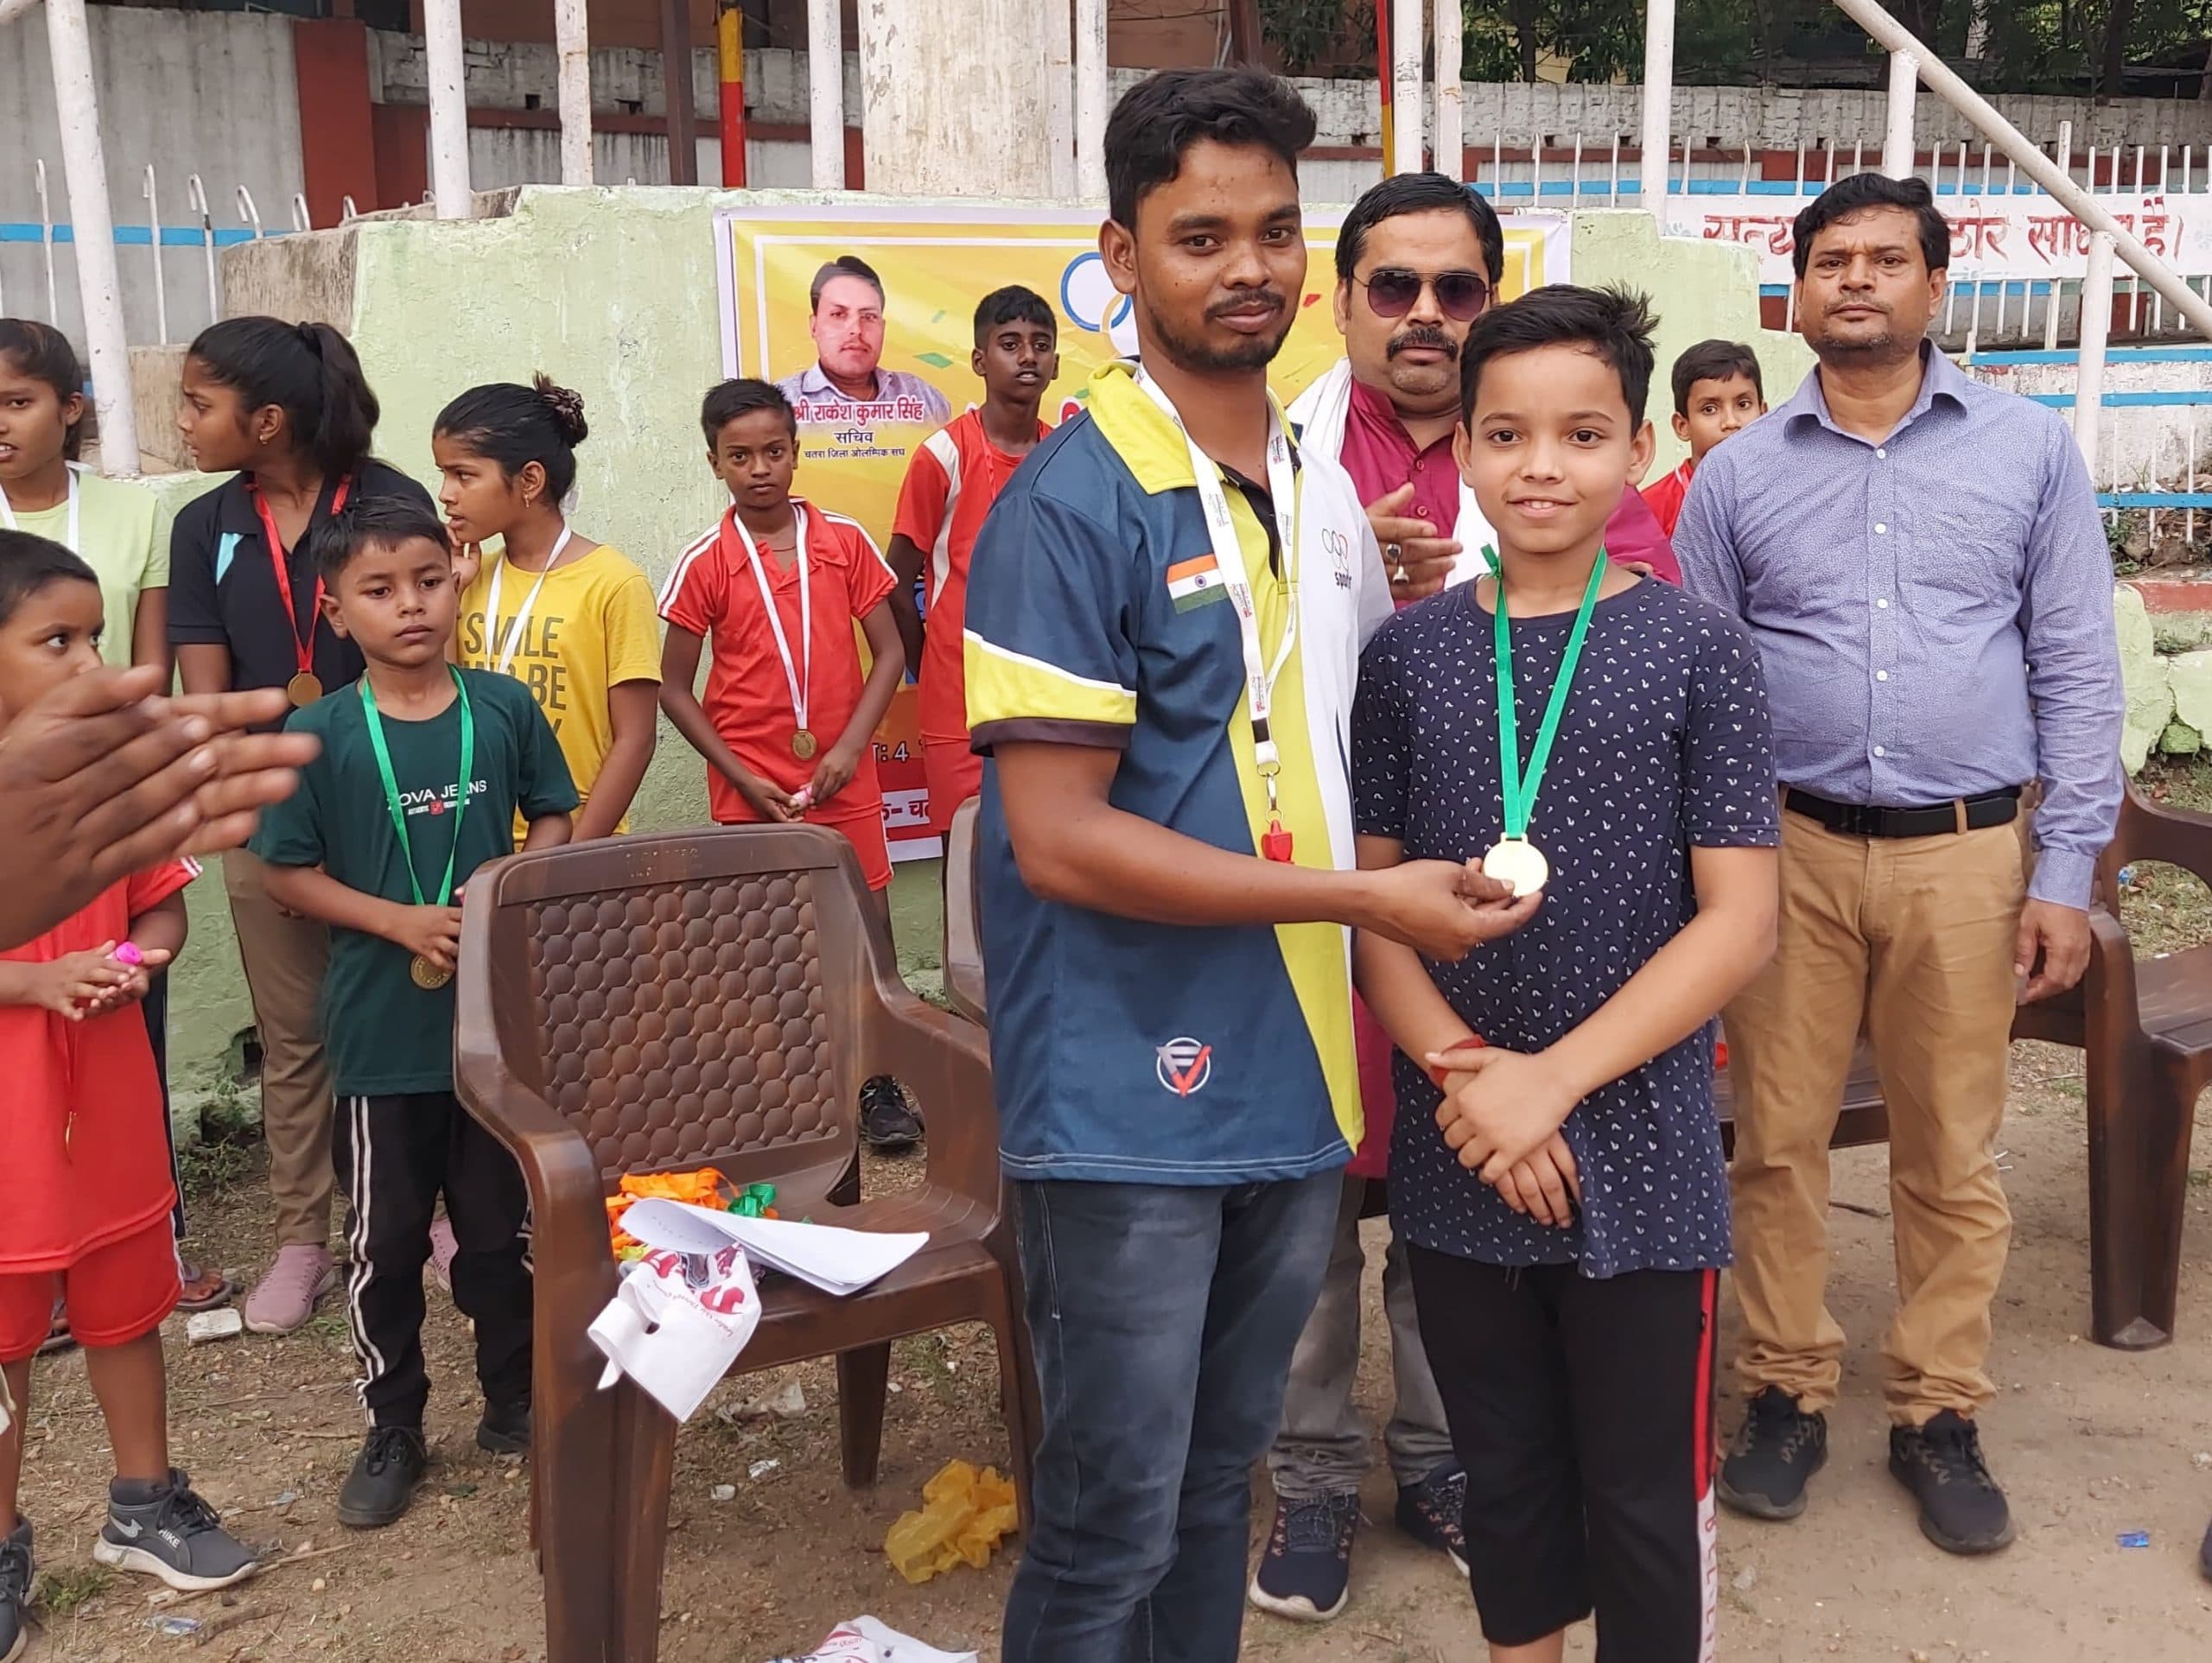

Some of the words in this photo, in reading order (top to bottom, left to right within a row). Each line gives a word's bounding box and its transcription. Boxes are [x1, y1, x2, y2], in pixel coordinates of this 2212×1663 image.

[814, 400, 852, 422] राकेश
[856, 403, 894, 426] कुमार
[898, 396, 924, 421] सिंह
[835, 428, 874, 444] सचिव
[528, 663, 567, 710] BE
[386, 788, 435, 811] OVA
[441, 779, 487, 798] JENS
